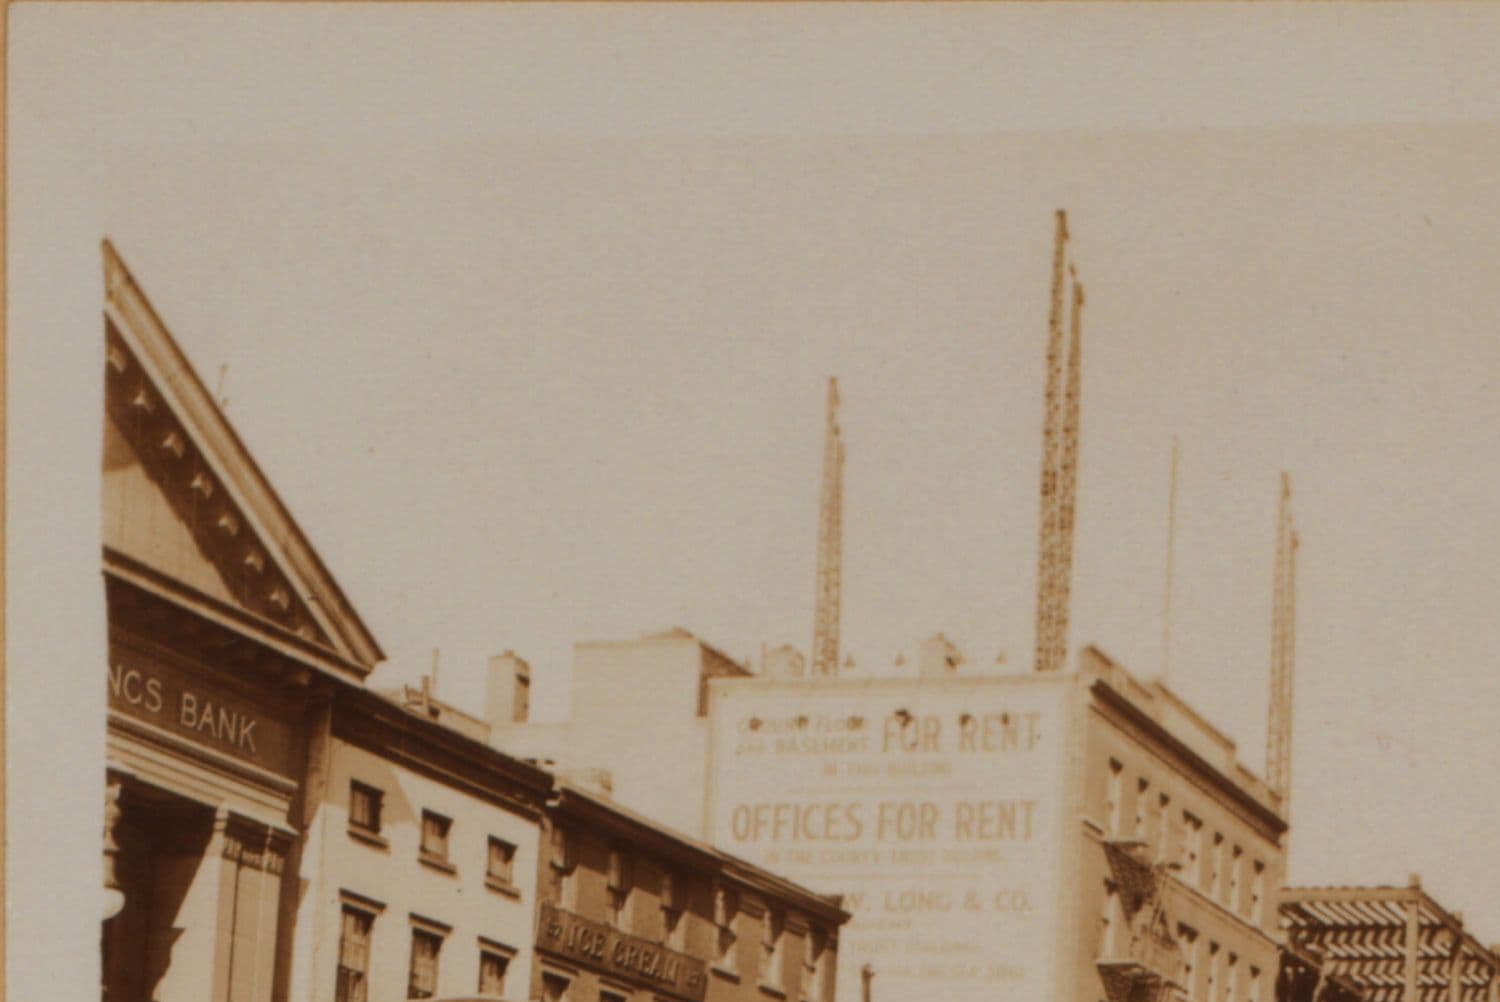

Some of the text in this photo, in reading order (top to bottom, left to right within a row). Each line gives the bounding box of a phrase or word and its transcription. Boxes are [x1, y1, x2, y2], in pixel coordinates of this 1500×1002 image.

[180, 691, 257, 753] BANK
[882, 713, 942, 753] FOR
[957, 713, 1041, 753] RENT
[732, 801, 1037, 842] OFFICES FOR RENT
[884, 890, 953, 913] LONG
[963, 890, 982, 913] &
[995, 889, 1034, 913] CO.
[567, 925, 681, 983] ICE CREAM
